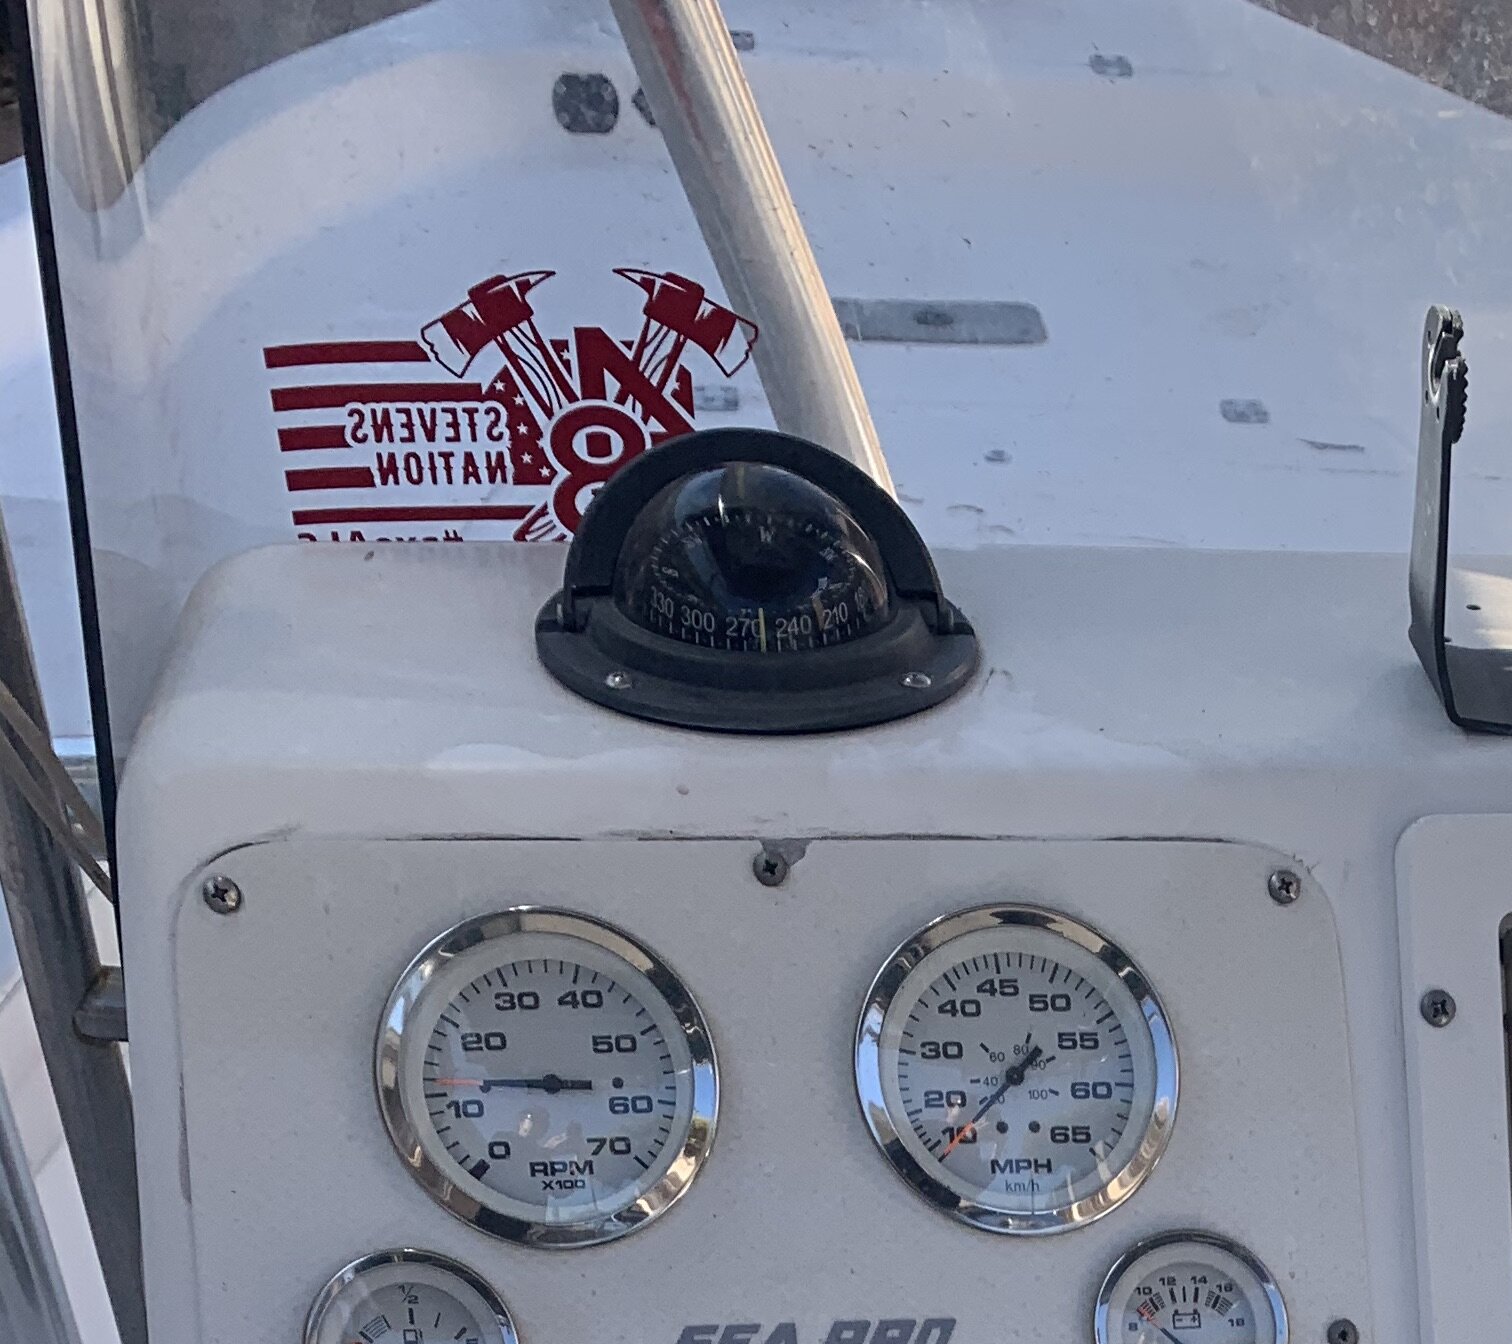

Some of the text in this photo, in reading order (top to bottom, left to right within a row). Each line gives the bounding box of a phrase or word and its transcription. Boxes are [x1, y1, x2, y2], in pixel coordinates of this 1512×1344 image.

[681, 604, 715, 632] 300
[775, 615, 812, 638] 240
[823, 602, 848, 629] 210
[976, 978, 1020, 997] 45
[494, 989, 603, 1011] 30 40
[938, 999, 981, 1018] 40
[1029, 993, 1072, 1012] 50
[461, 1031, 507, 1052] 20
[592, 1034, 637, 1054] 50
[1057, 1032, 1100, 1050] 55
[920, 1042, 963, 1060] 30
[983, 1076, 998, 1087] 40
[924, 1090, 967, 1108] 20
[1028, 1089, 1048, 1100] 100
[1070, 1082, 1113, 1100] 60
[446, 1099, 485, 1119] 10
[609, 1095, 653, 1115] 60
[941, 1126, 978, 1144] 10
[1050, 1126, 1092, 1144] 65
[488, 1141, 511, 1160] 0
[586, 1136, 631, 1156] 70
[529, 1160, 594, 1177] RPM
[990, 1158, 1053, 1174] MPH
[1005, 1180, 1040, 1193] km/h
[1159, 1275, 1208, 1286] 12 14
[1134, 1286, 1153, 1297] 10
